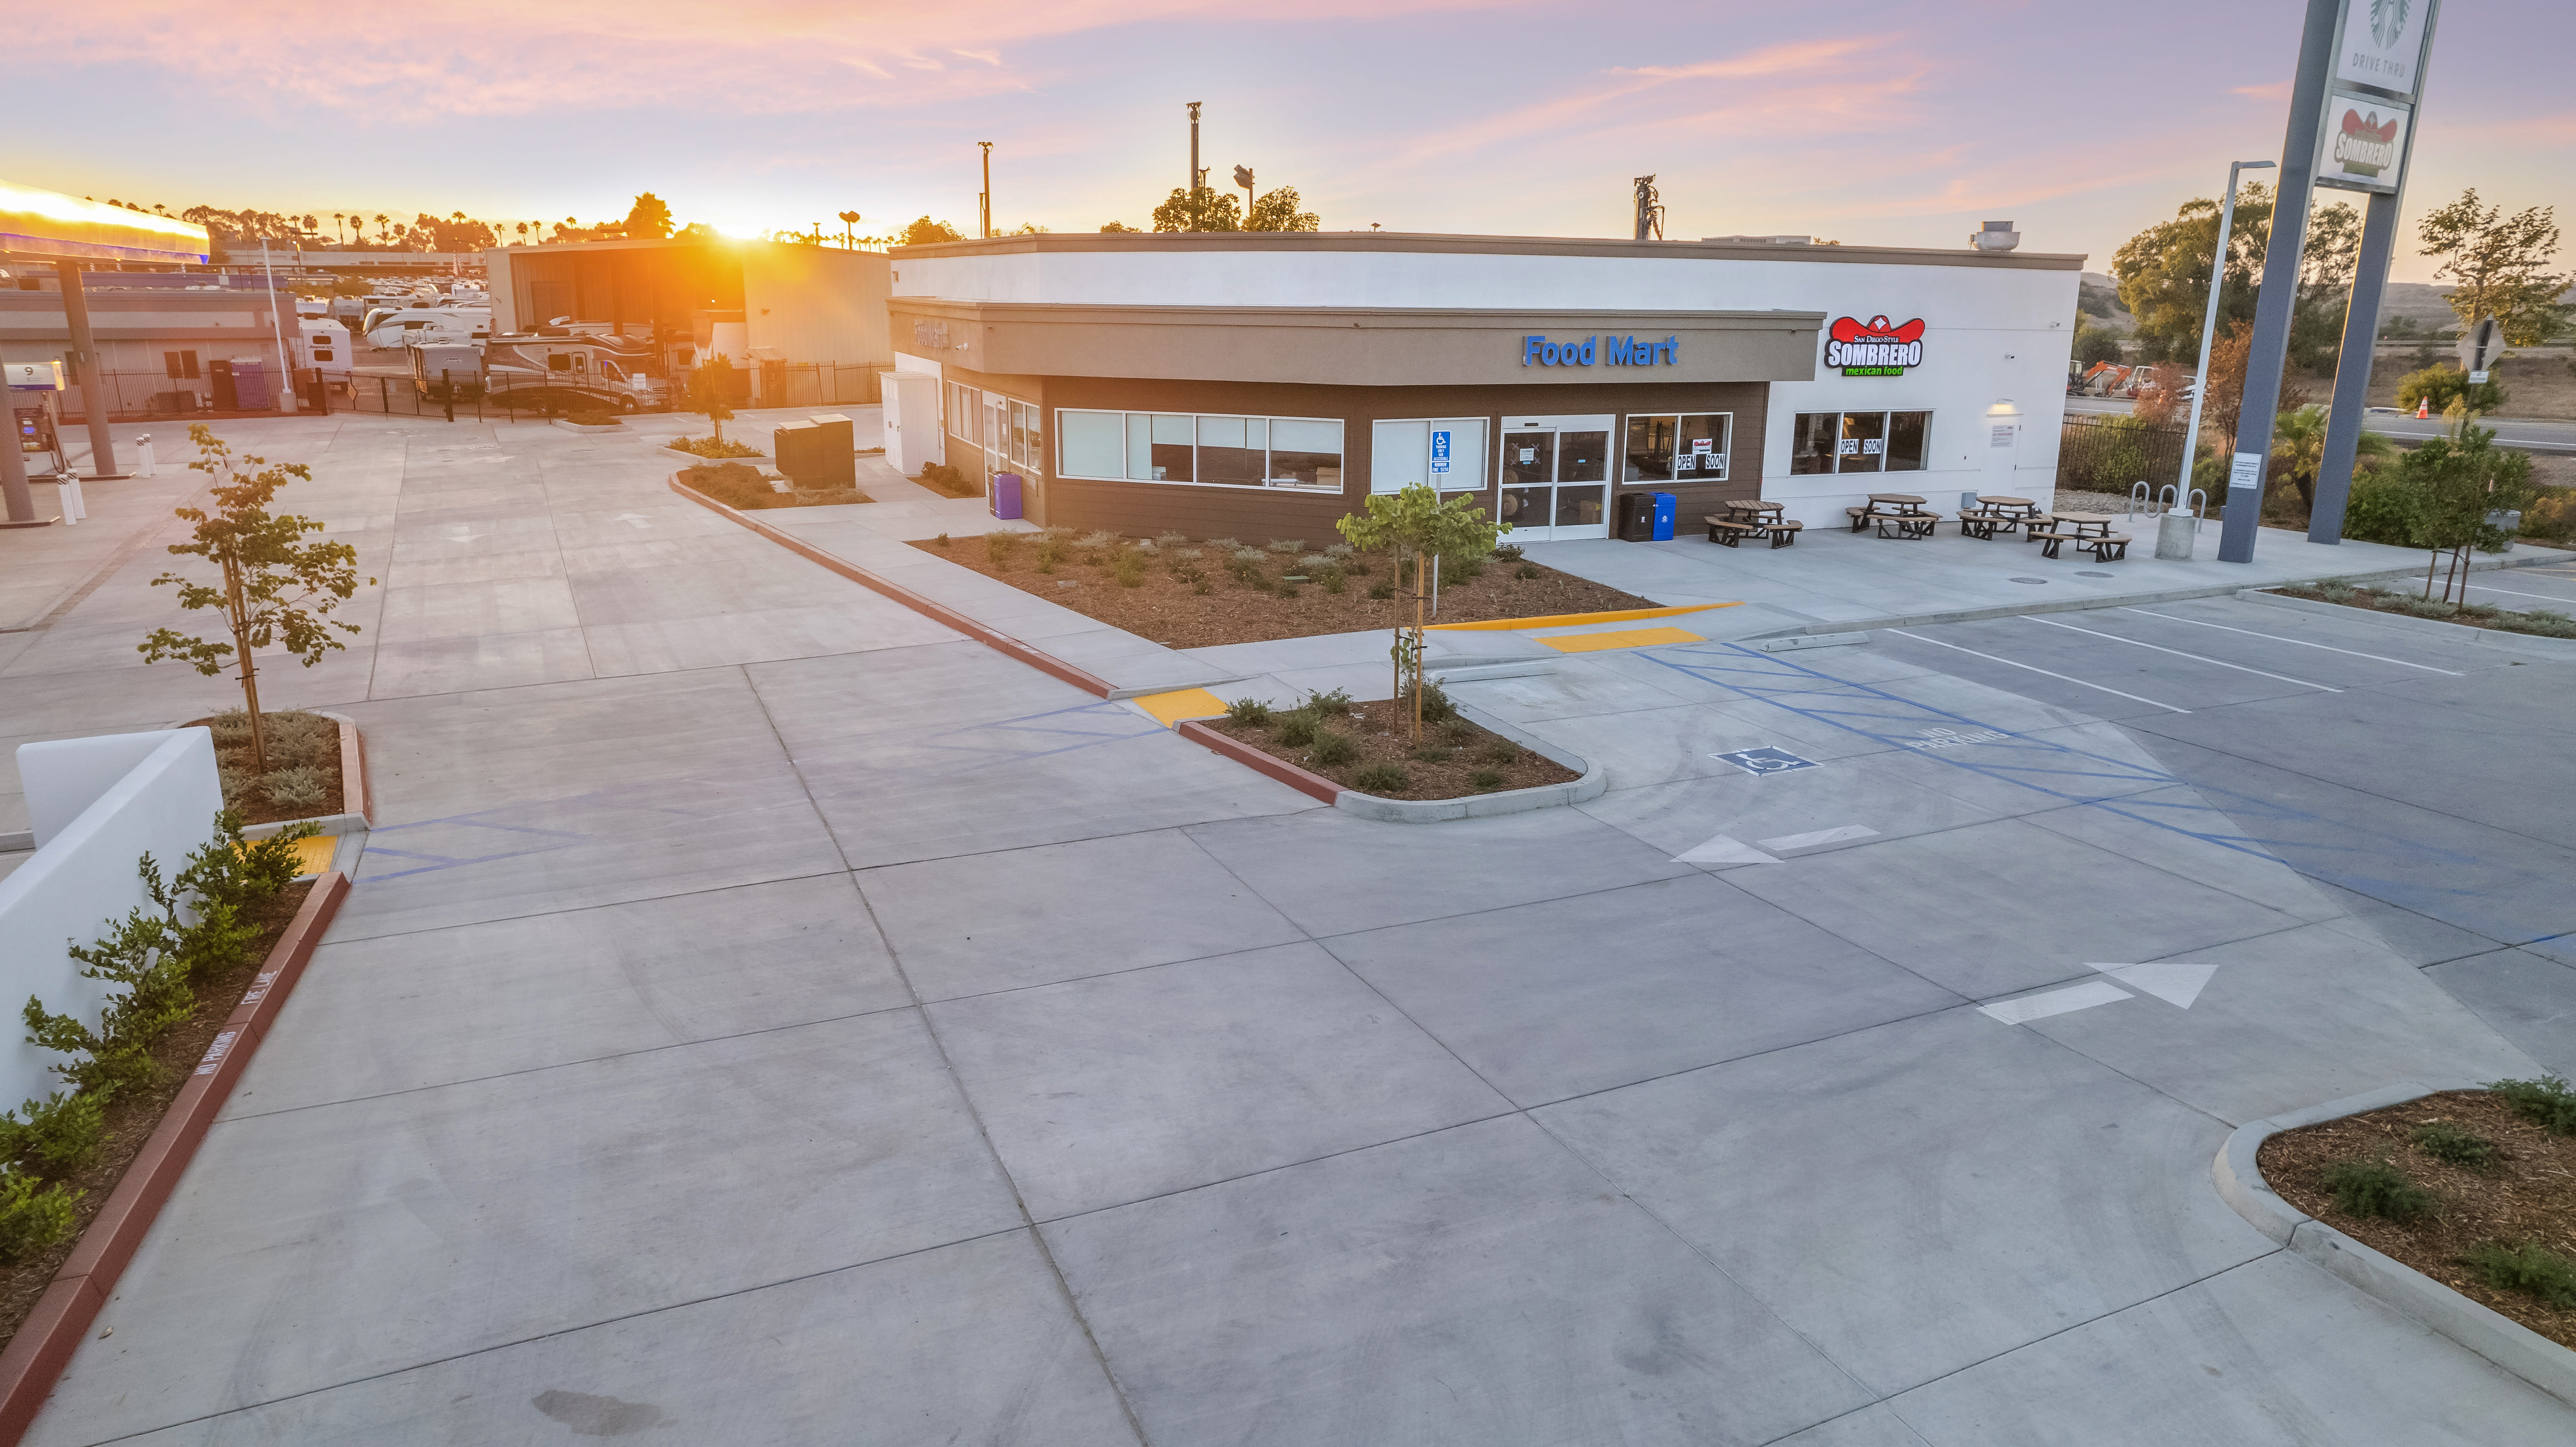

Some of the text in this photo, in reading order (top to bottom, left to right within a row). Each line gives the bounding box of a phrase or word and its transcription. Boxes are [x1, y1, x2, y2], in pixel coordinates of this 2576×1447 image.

[2352, 52, 2405, 77] DRIVE THRU
[2336, 133, 2393, 167] SOMBRERO
[1526, 335, 1679, 366] Food Mart
[1828, 340, 1921, 366] SOMBRERO
[25, 367, 33, 375] 9
[1846, 366, 1903, 375] mexican food
[1841, 440, 1881, 453] OPEN SOON
[1678, 455, 1724, 469] OPEN SOON
[1905, 731, 2009, 750] PARKING
[1915, 728, 1957, 737] NO
[240, 970, 277, 1004] FIRE LANE
[194, 1031, 236, 1075] NO PARKING
